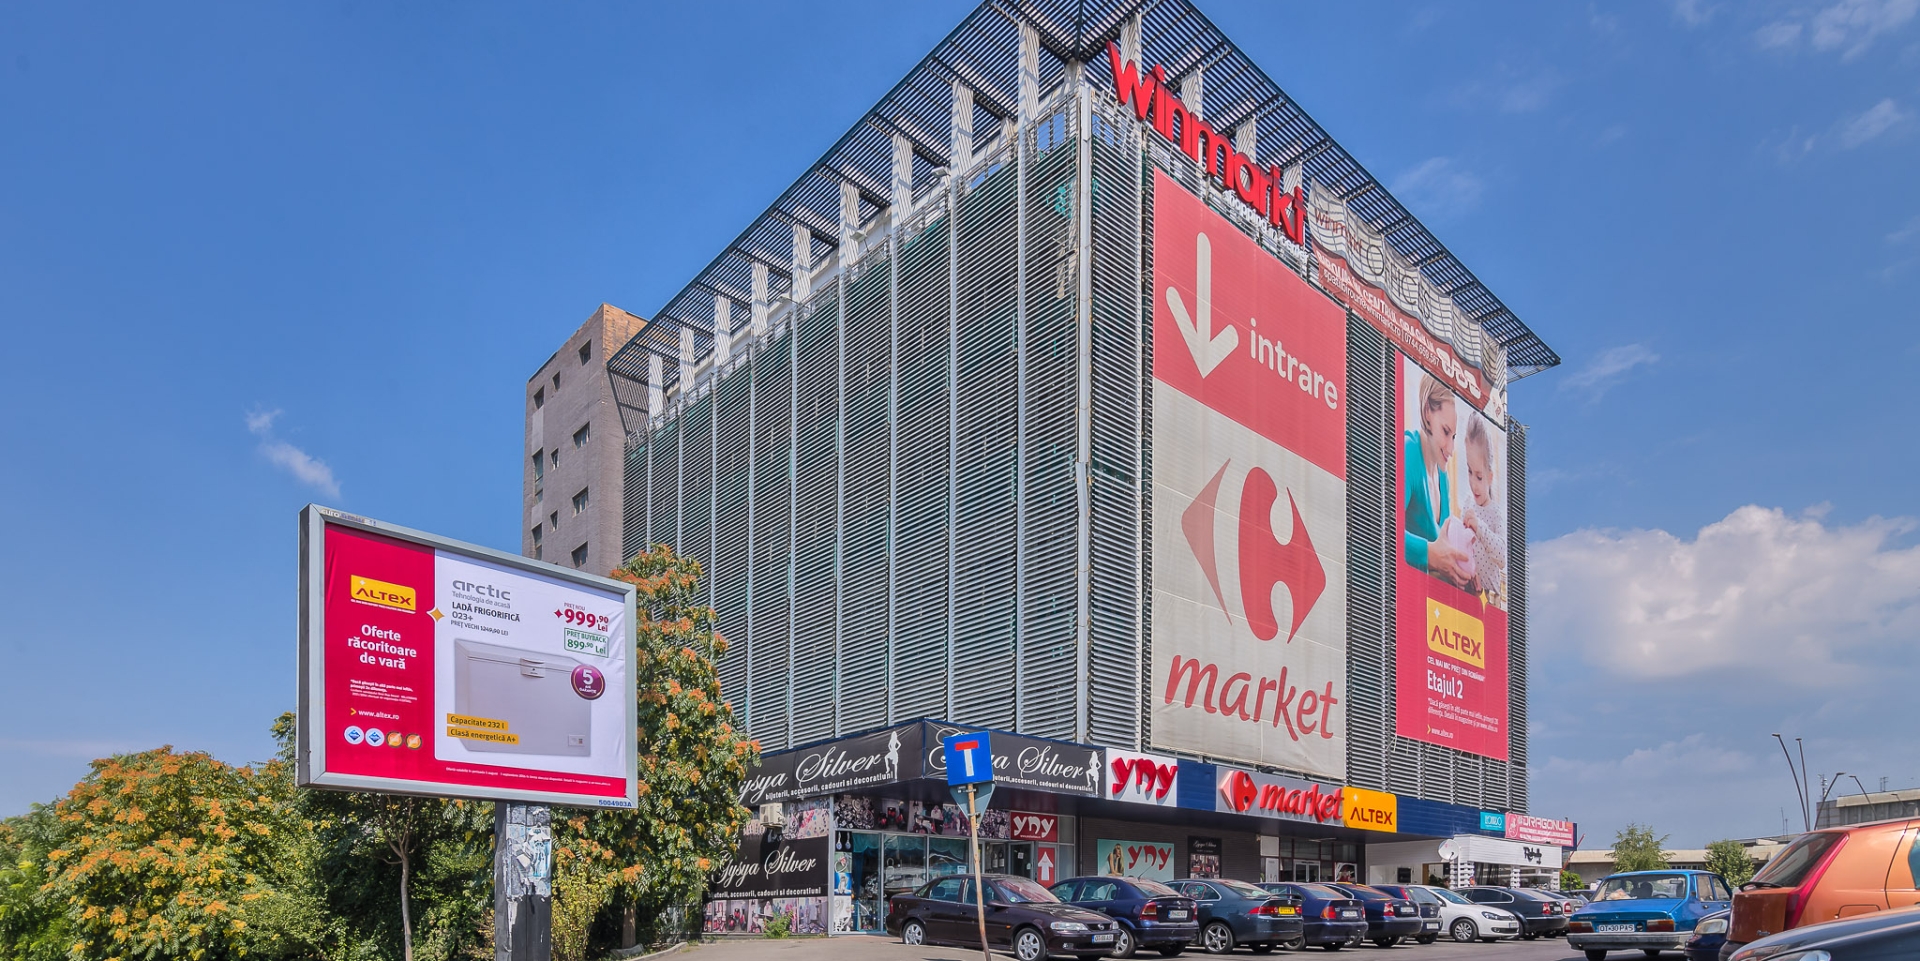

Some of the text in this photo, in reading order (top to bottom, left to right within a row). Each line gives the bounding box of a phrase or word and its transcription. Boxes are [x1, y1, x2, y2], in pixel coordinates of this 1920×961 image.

[1107, 40, 1307, 246] winmarkt
[1250, 318, 1339, 410] intrare
[452, 579, 511, 601] arctic
[452, 590, 485, 604] Tehnologia
[485, 598, 493, 606] de
[452, 601, 521, 622] LADĂ FRIGORIFICĂ
[361, 624, 401, 641] Oferte
[463, 622, 480, 630] VECHI
[597, 623, 608, 632] Lei
[347, 636, 417, 657] răcoritoare
[595, 646, 606, 654] Lei
[360, 652, 406, 669] de vară
[582, 669, 594, 685] 5
[1427, 669, 1456, 699] Etajul
[1457, 680, 1463, 699] 2
[1164, 654, 1339, 742] market
[358, 710, 400, 720] www.altex.ro
[450, 716, 487, 727] Capacitate
[487, 721, 501, 729] 232
[450, 728, 516, 743] Clasă energetică A+
[1017, 745, 1084, 779] Silver
[733, 745, 882, 805] ysya Silver
[790, 785, 820, 797] accesorii,
[821, 779, 846, 791] cadouri
[846, 778, 853, 787] si
[853, 771, 894, 785] decoratiuni
[1111, 756, 1179, 801] yny
[1039, 780, 1060, 788] cadouri
[1065, 783, 1094, 792] decoratiuni
[1259, 783, 1346, 823] market
[1013, 815, 1055, 838] yny
[764, 845, 817, 880] Silver
[730, 890, 757, 898] accesorii,
[757, 889, 779, 897] cadouri
[779, 888, 785, 896] si
[785, 887, 821, 895] decoratiuni
